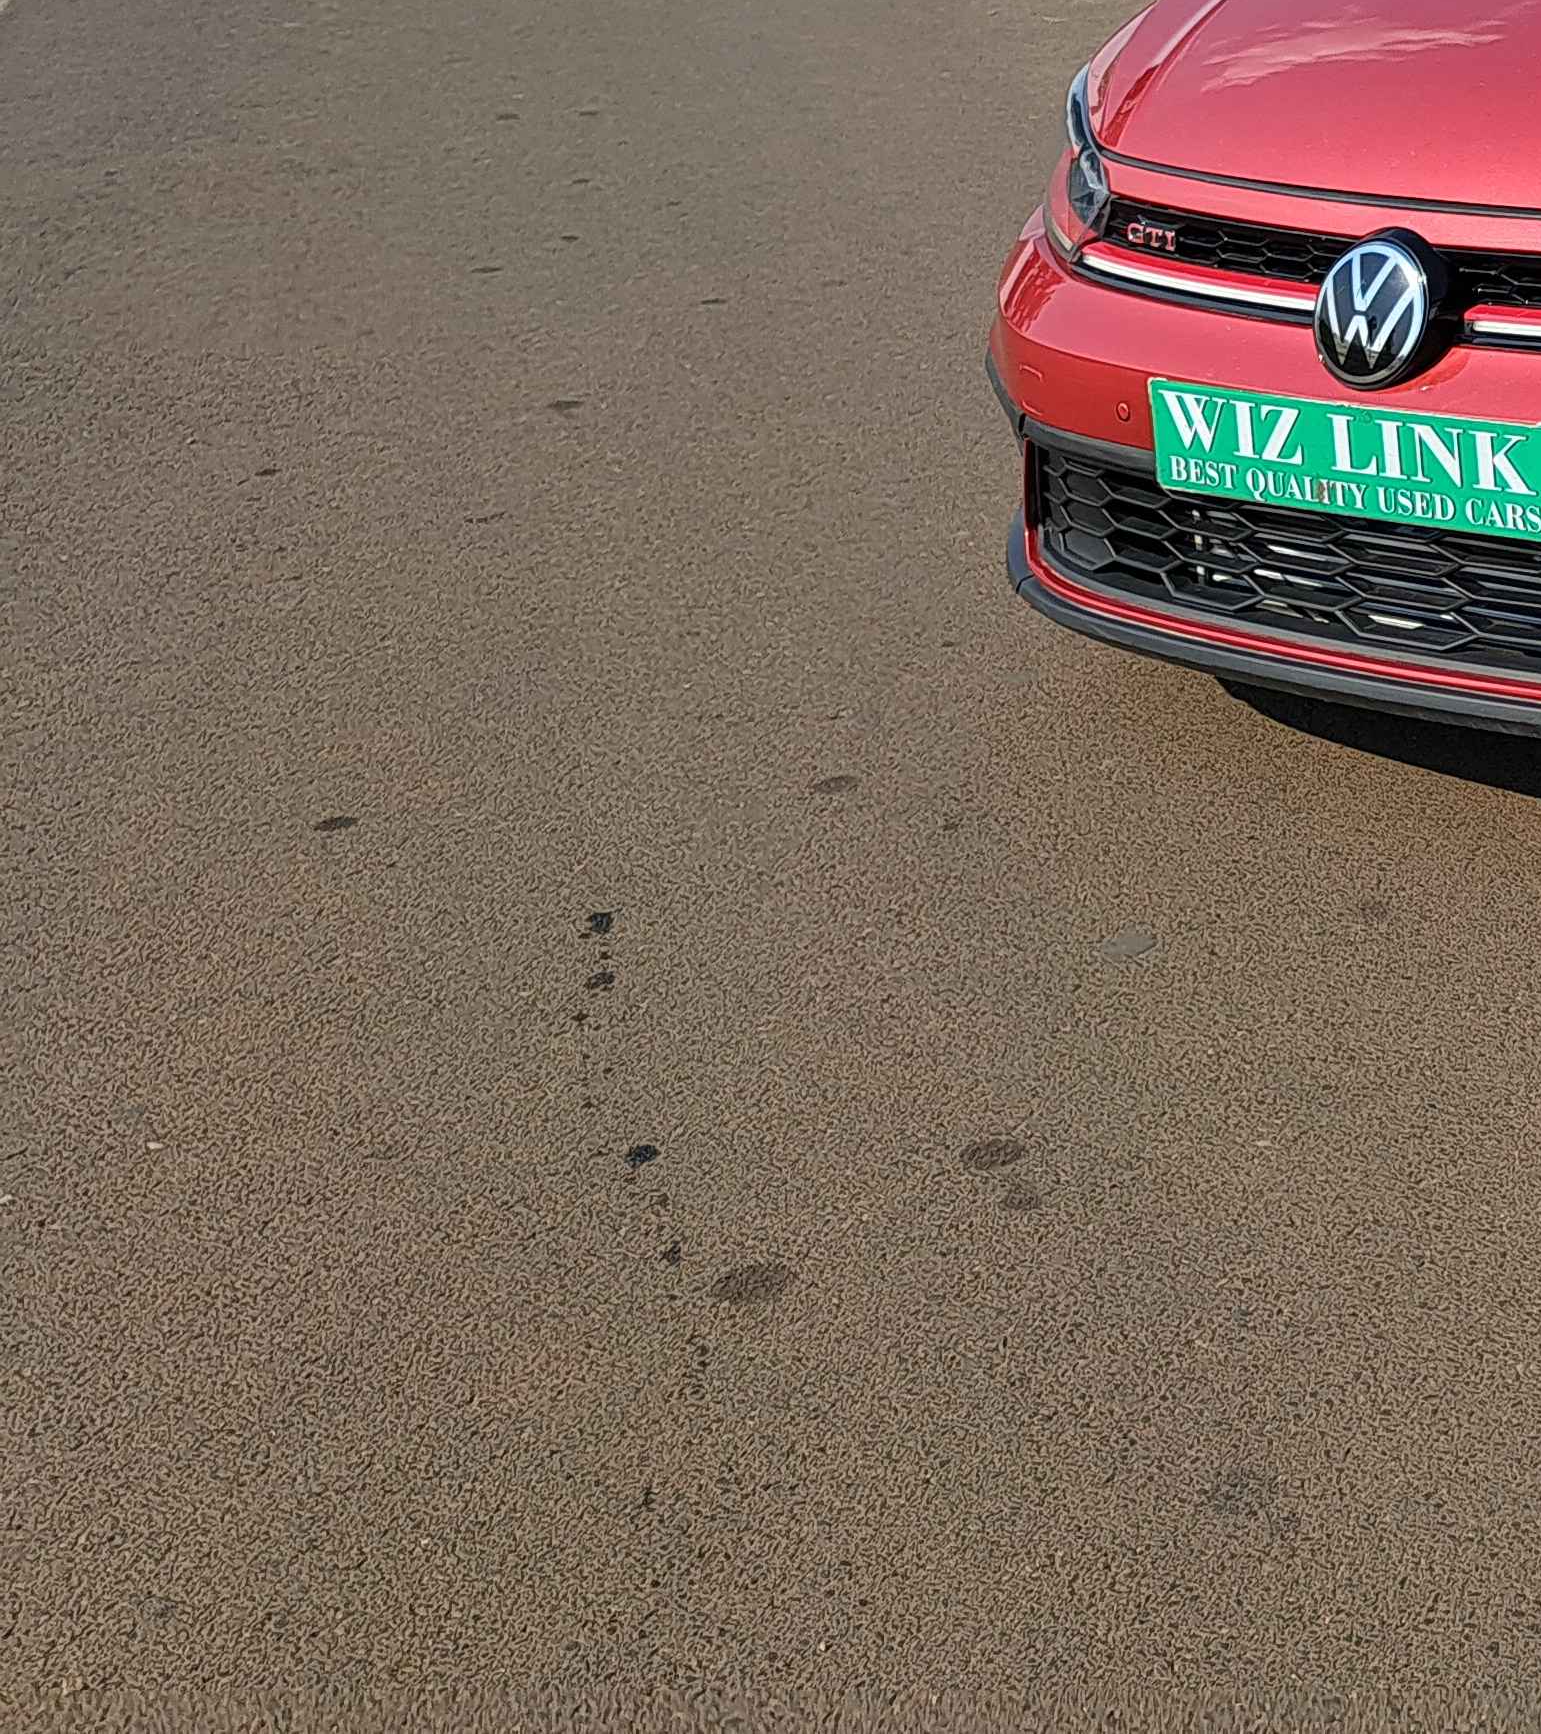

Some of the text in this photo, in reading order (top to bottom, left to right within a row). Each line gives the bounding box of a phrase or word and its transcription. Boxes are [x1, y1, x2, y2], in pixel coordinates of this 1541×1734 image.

[1127, 222, 1176, 252] GTI
[1158, 389, 1537, 496] WIZ LINK
[1169, 456, 1236, 489] BEST
[1246, 468, 1367, 510] QUALITY
[1377, 487, 1455, 521] USED
